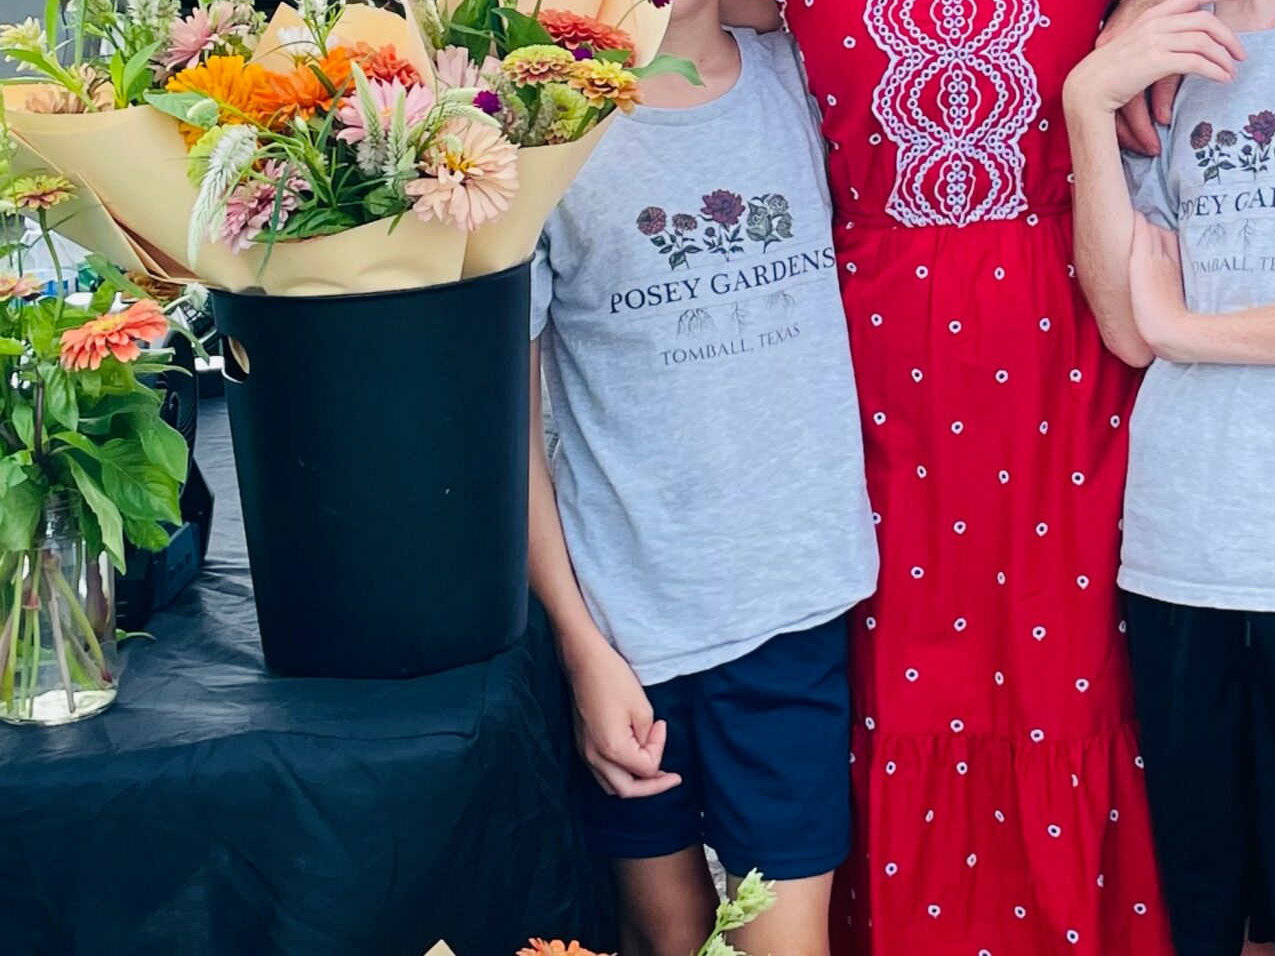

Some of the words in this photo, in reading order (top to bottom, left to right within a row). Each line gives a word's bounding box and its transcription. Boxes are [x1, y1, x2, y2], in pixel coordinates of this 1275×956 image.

[609, 278, 701, 314] POSEY
[710, 246, 836, 296] GARDENS
[659, 338, 754, 366] TOMBALL,
[759, 322, 801, 350] TEXAS
